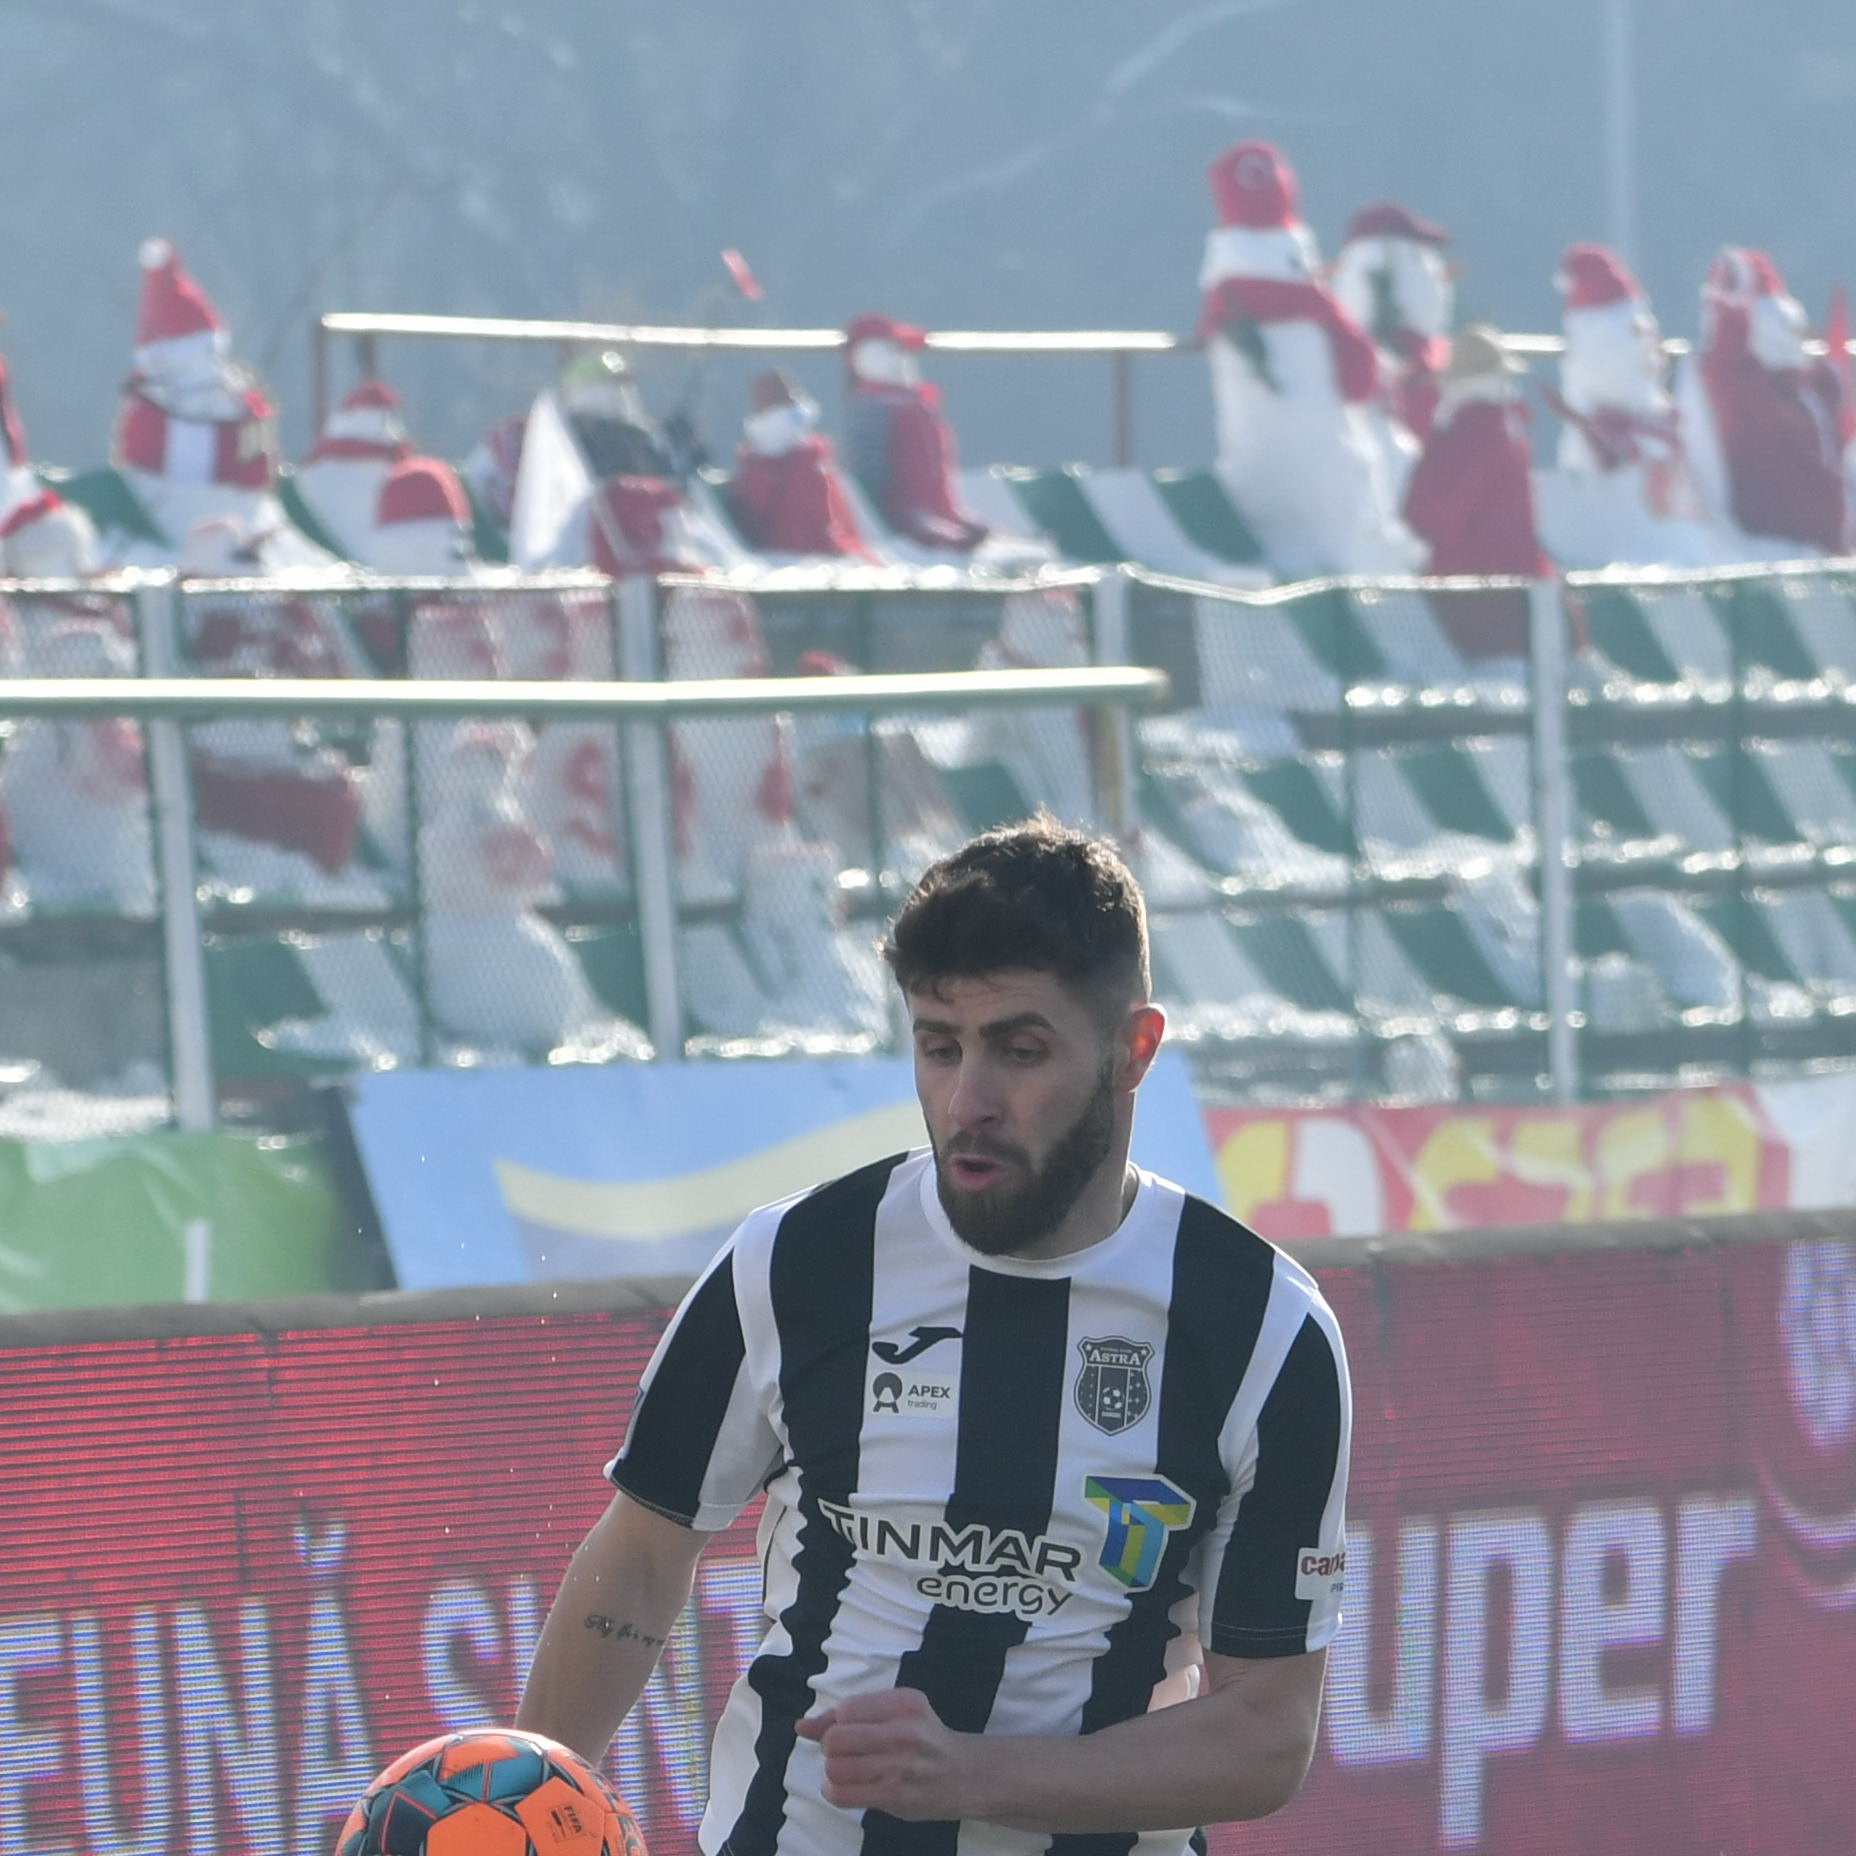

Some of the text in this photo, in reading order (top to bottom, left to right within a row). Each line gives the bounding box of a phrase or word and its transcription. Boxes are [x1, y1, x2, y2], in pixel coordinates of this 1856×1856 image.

[1089, 1349, 1141, 1366] ASTRA
[907, 1400, 938, 1411] trading
[908, 1384, 951, 1399] APEX
[823, 1503, 1082, 1582] TINMAR
[916, 1576, 1073, 1617] energy
[1322, 1491, 1759, 1853] uper
[563, 1804, 583, 1834] FIFA
